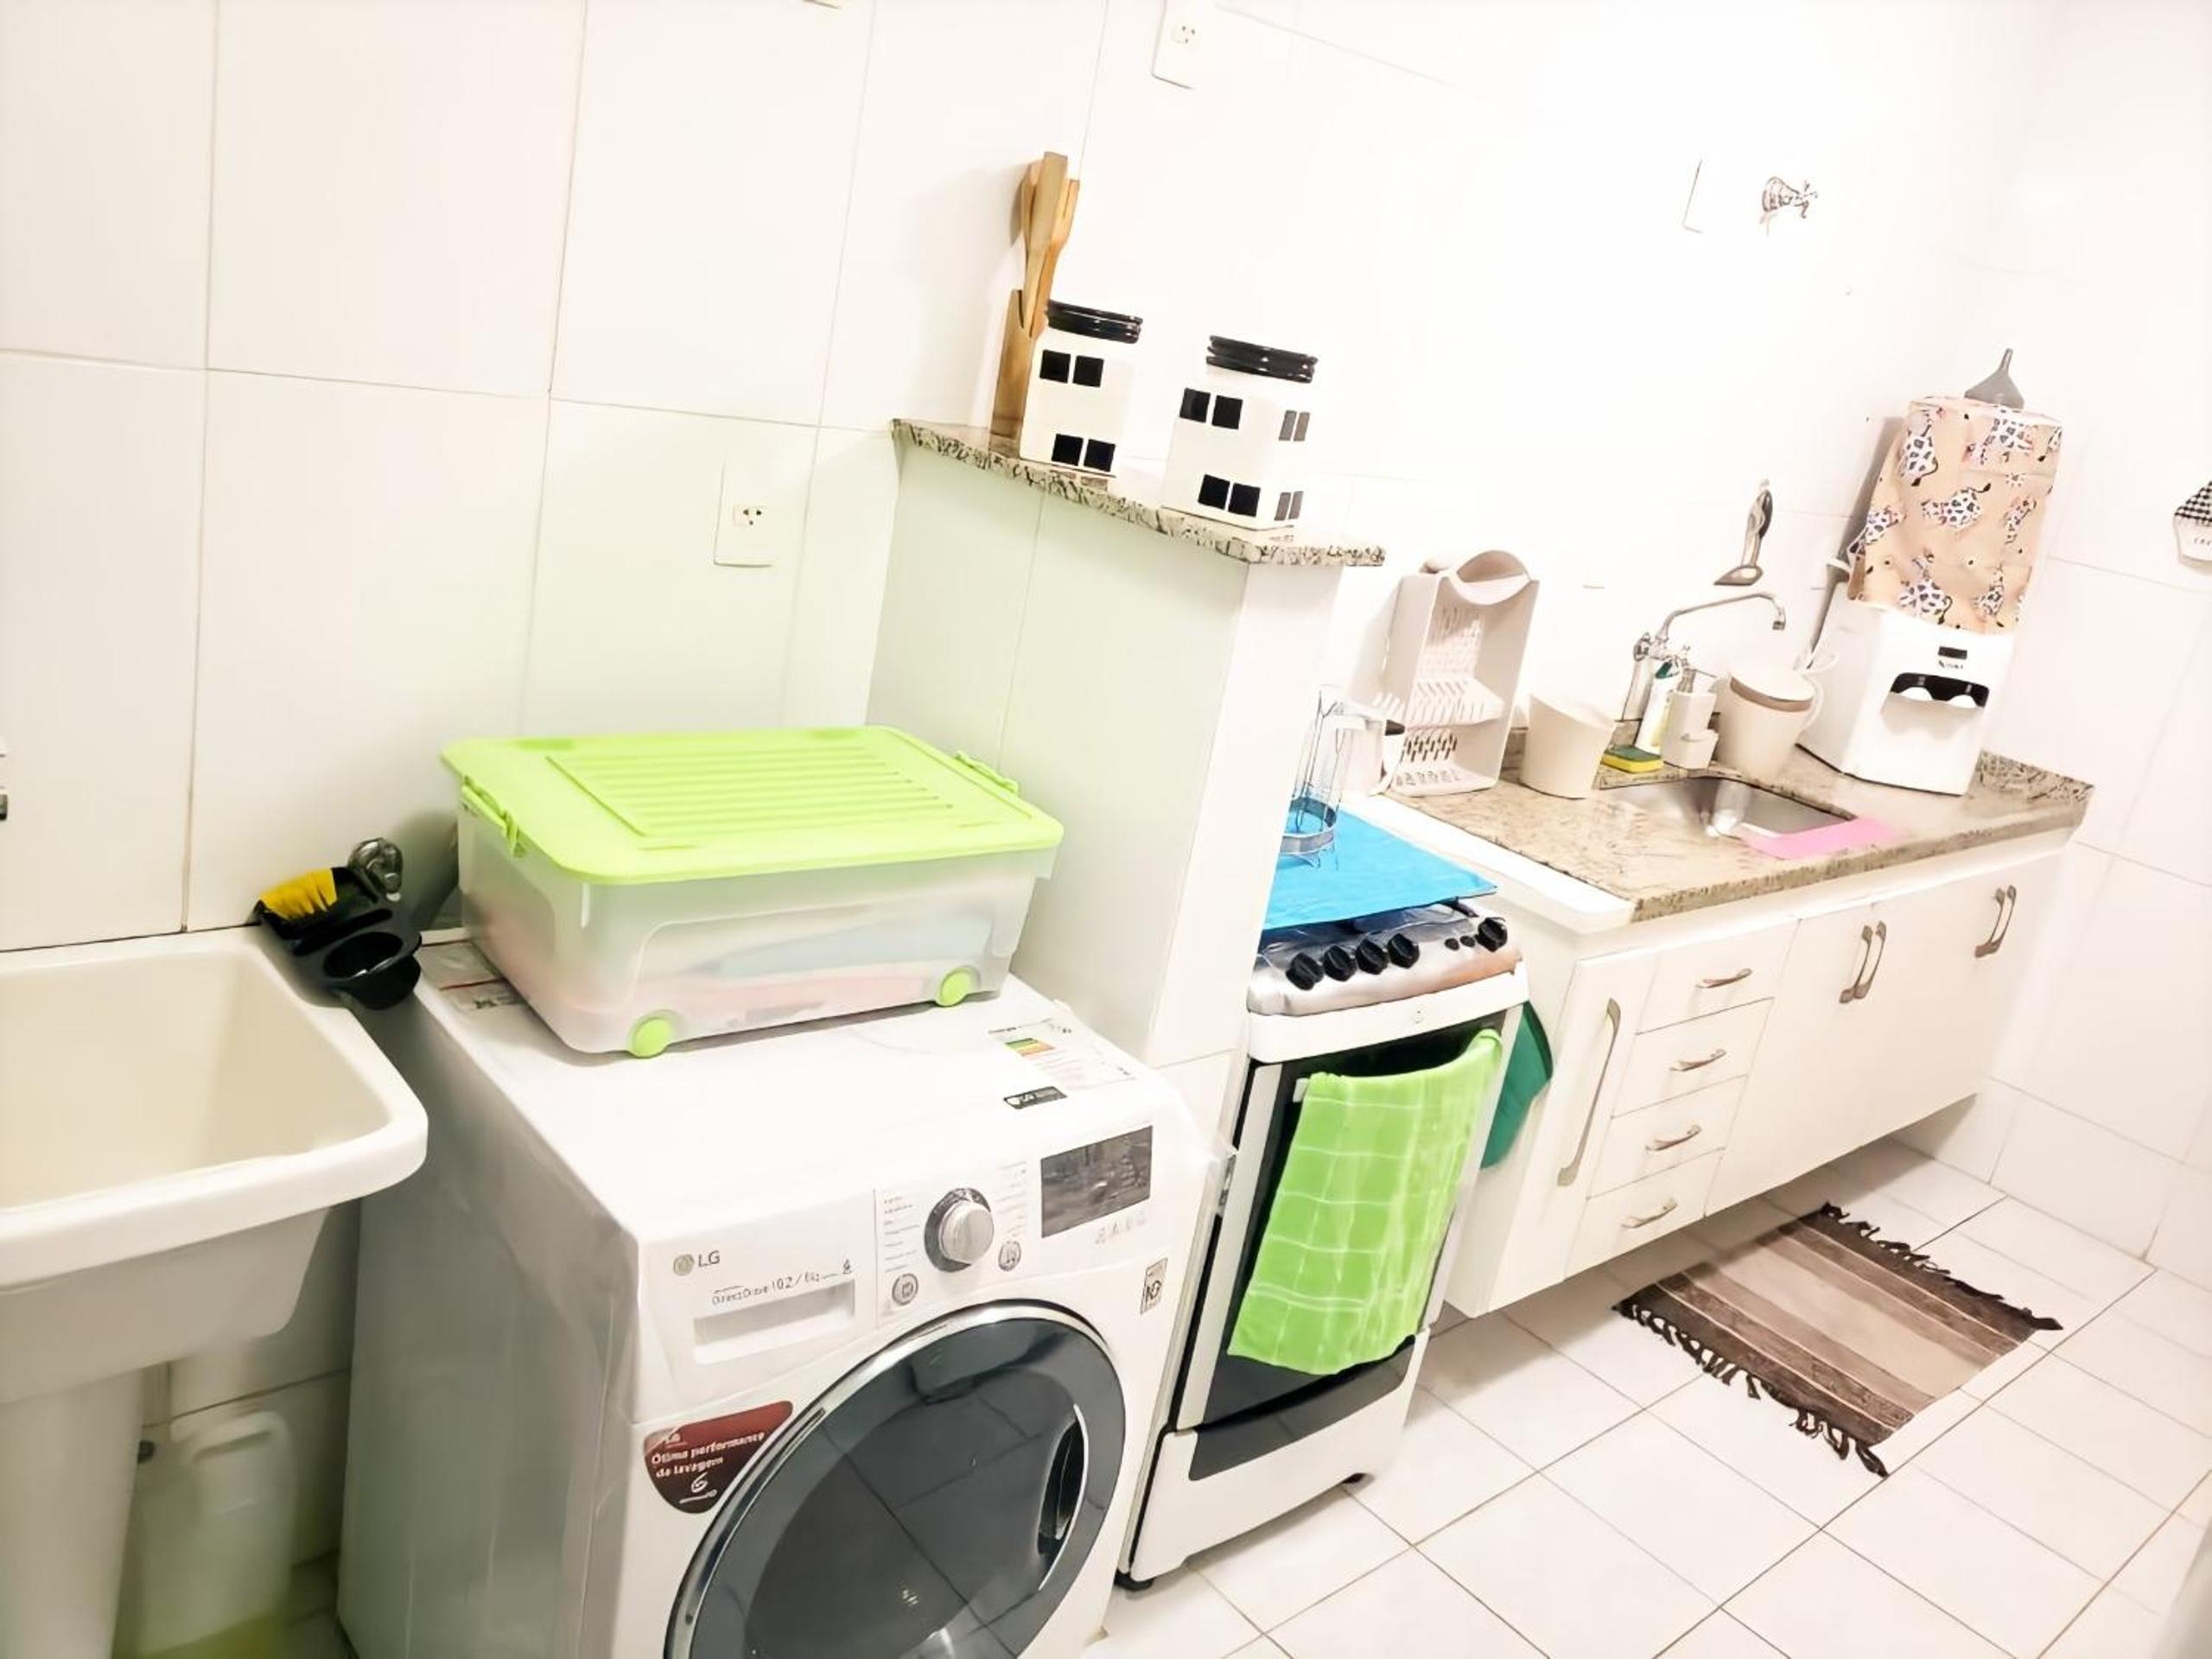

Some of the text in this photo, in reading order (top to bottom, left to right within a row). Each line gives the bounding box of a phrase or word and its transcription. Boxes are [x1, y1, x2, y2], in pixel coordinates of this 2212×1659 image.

[697, 1249, 721, 1268] LG
[656, 1457, 724, 1478] de lavagem
